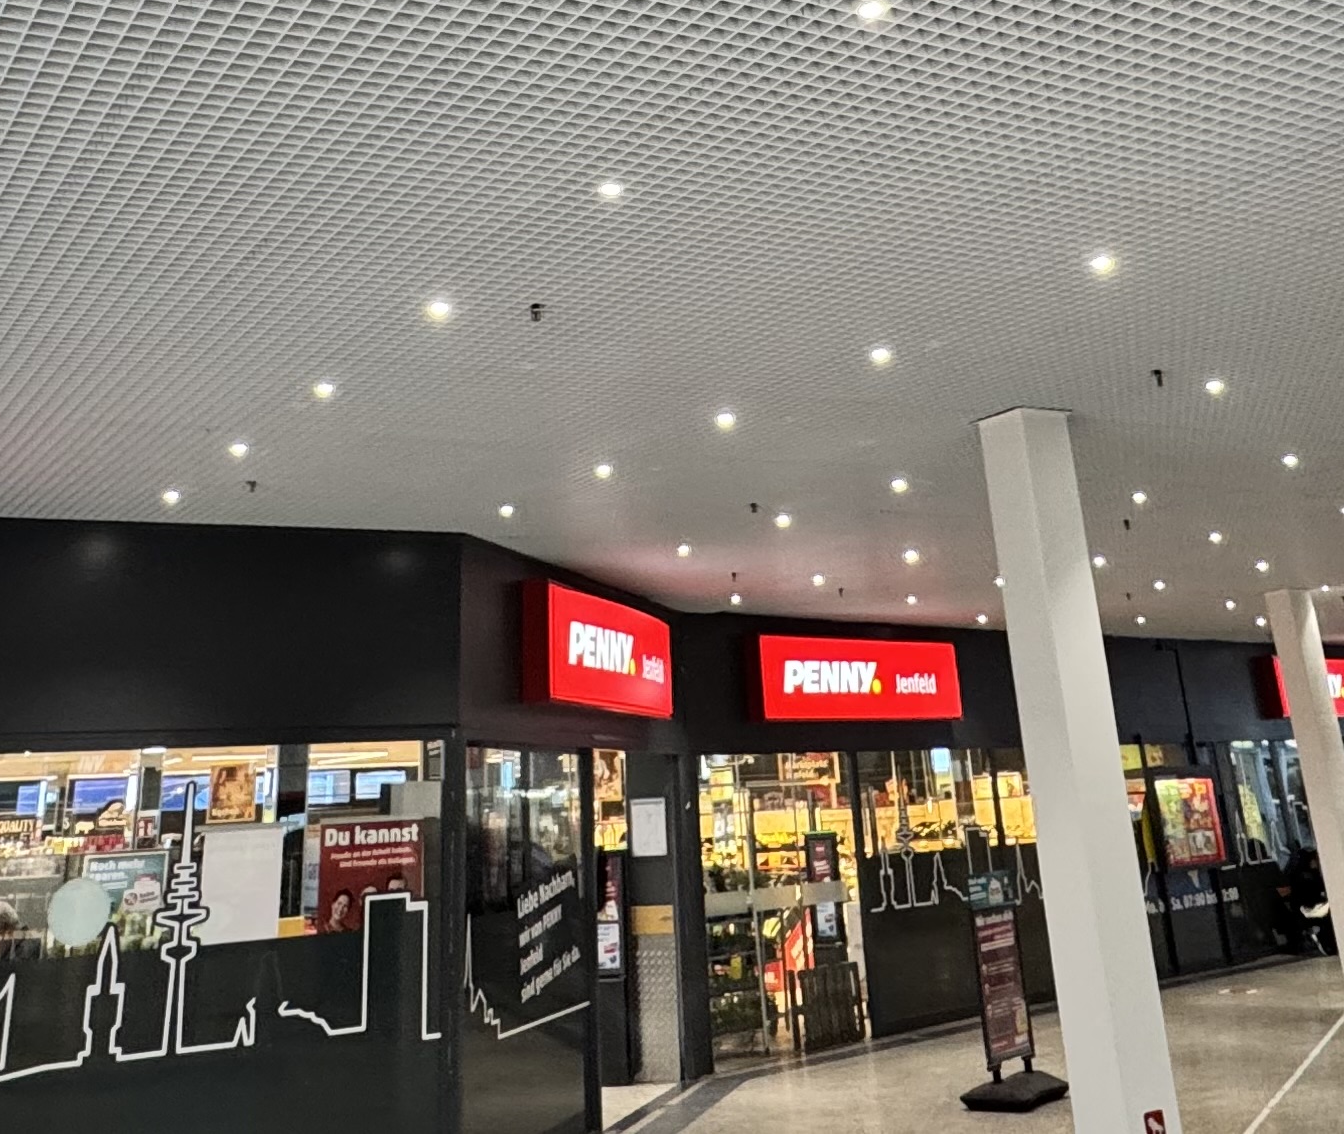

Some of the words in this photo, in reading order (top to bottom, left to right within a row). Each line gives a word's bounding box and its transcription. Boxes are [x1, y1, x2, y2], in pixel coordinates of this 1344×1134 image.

[567, 620, 637, 677] PENNY.
[783, 660, 882, 695] PENNY.
[895, 672, 938, 695] Jenfeld
[324, 828, 351, 847] Du
[354, 823, 419, 845] kannst
